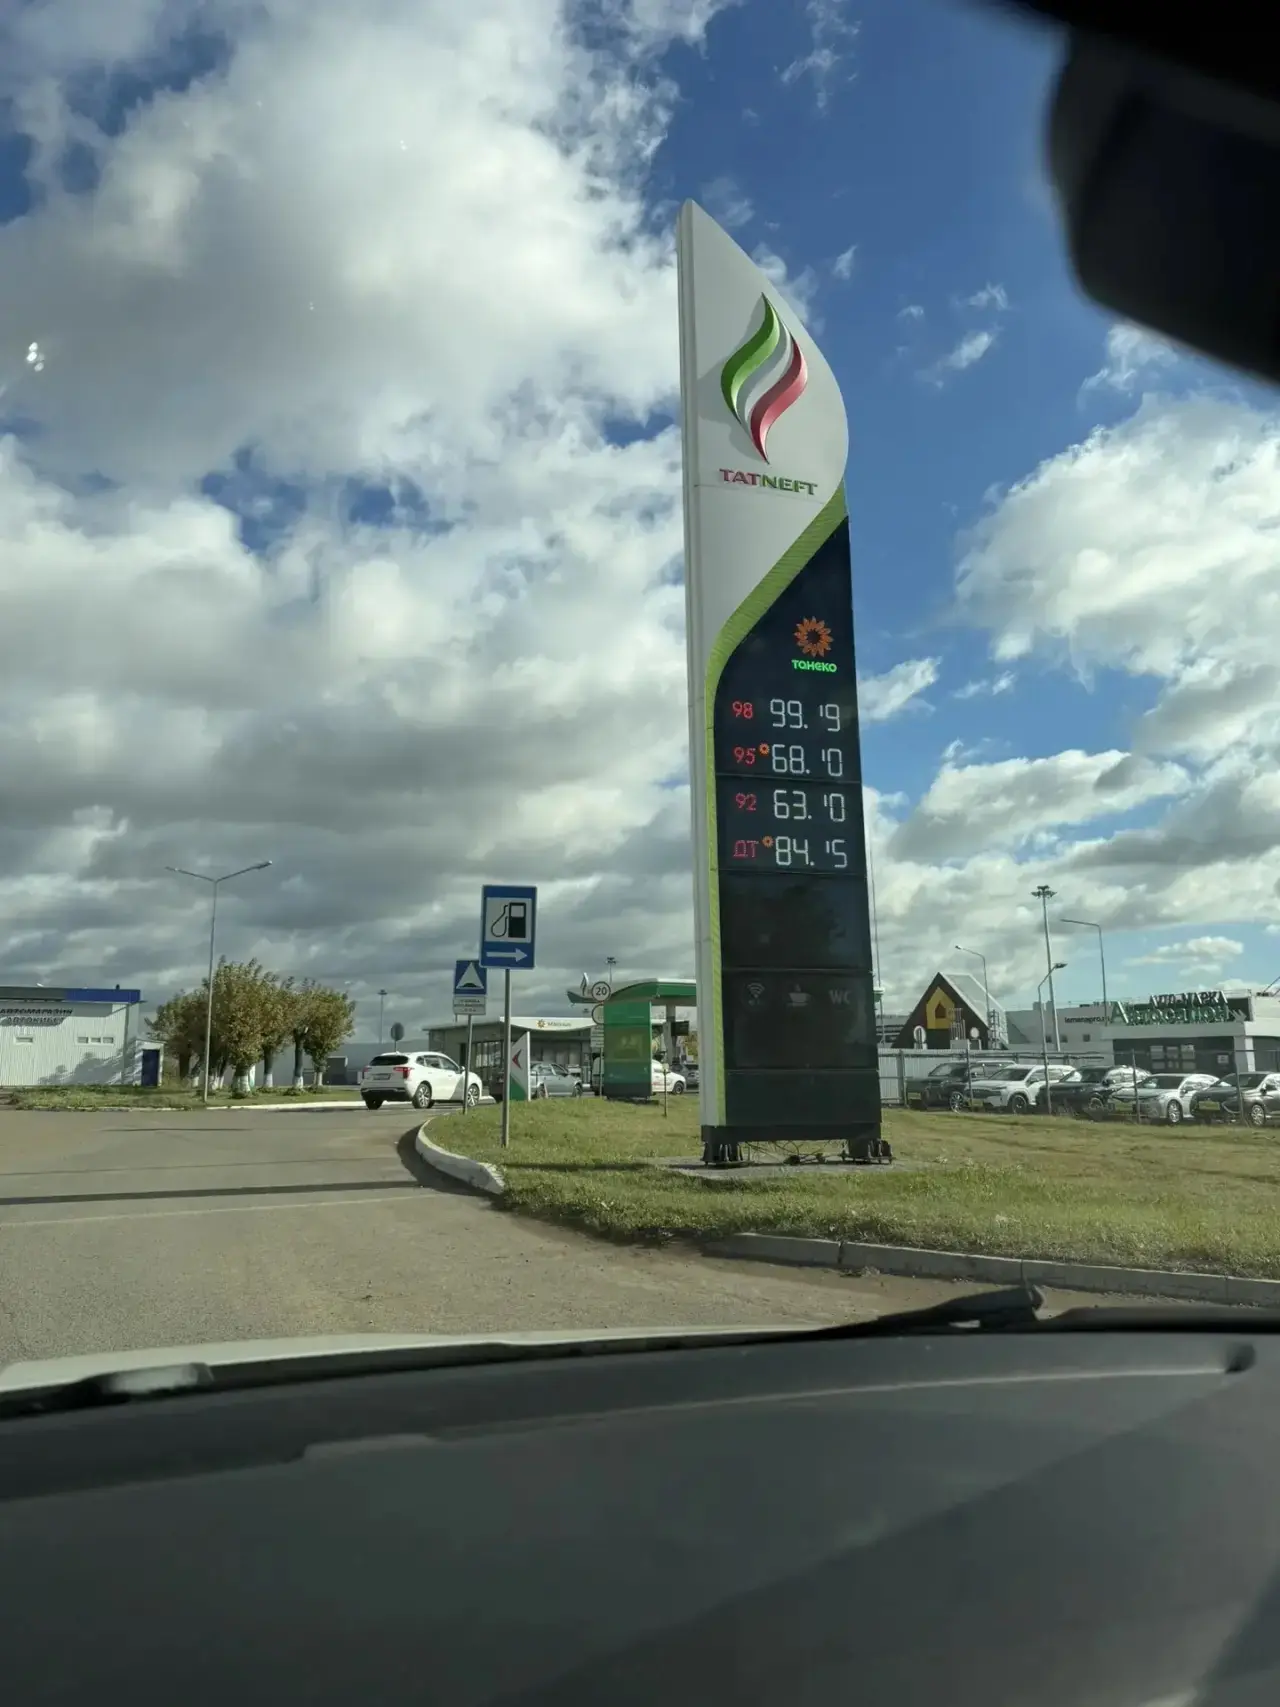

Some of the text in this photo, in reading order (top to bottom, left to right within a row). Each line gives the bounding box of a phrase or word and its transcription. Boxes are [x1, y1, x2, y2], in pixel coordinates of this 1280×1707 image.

[719, 469, 818, 495] TATNEFT
[732, 701, 753, 719] 98
[734, 746, 756, 765] 95
[735, 792, 757, 811] 92
[733, 839, 759, 858] ДТ
[595, 986, 608, 996] 20
[828, 989, 852, 1005] WC
